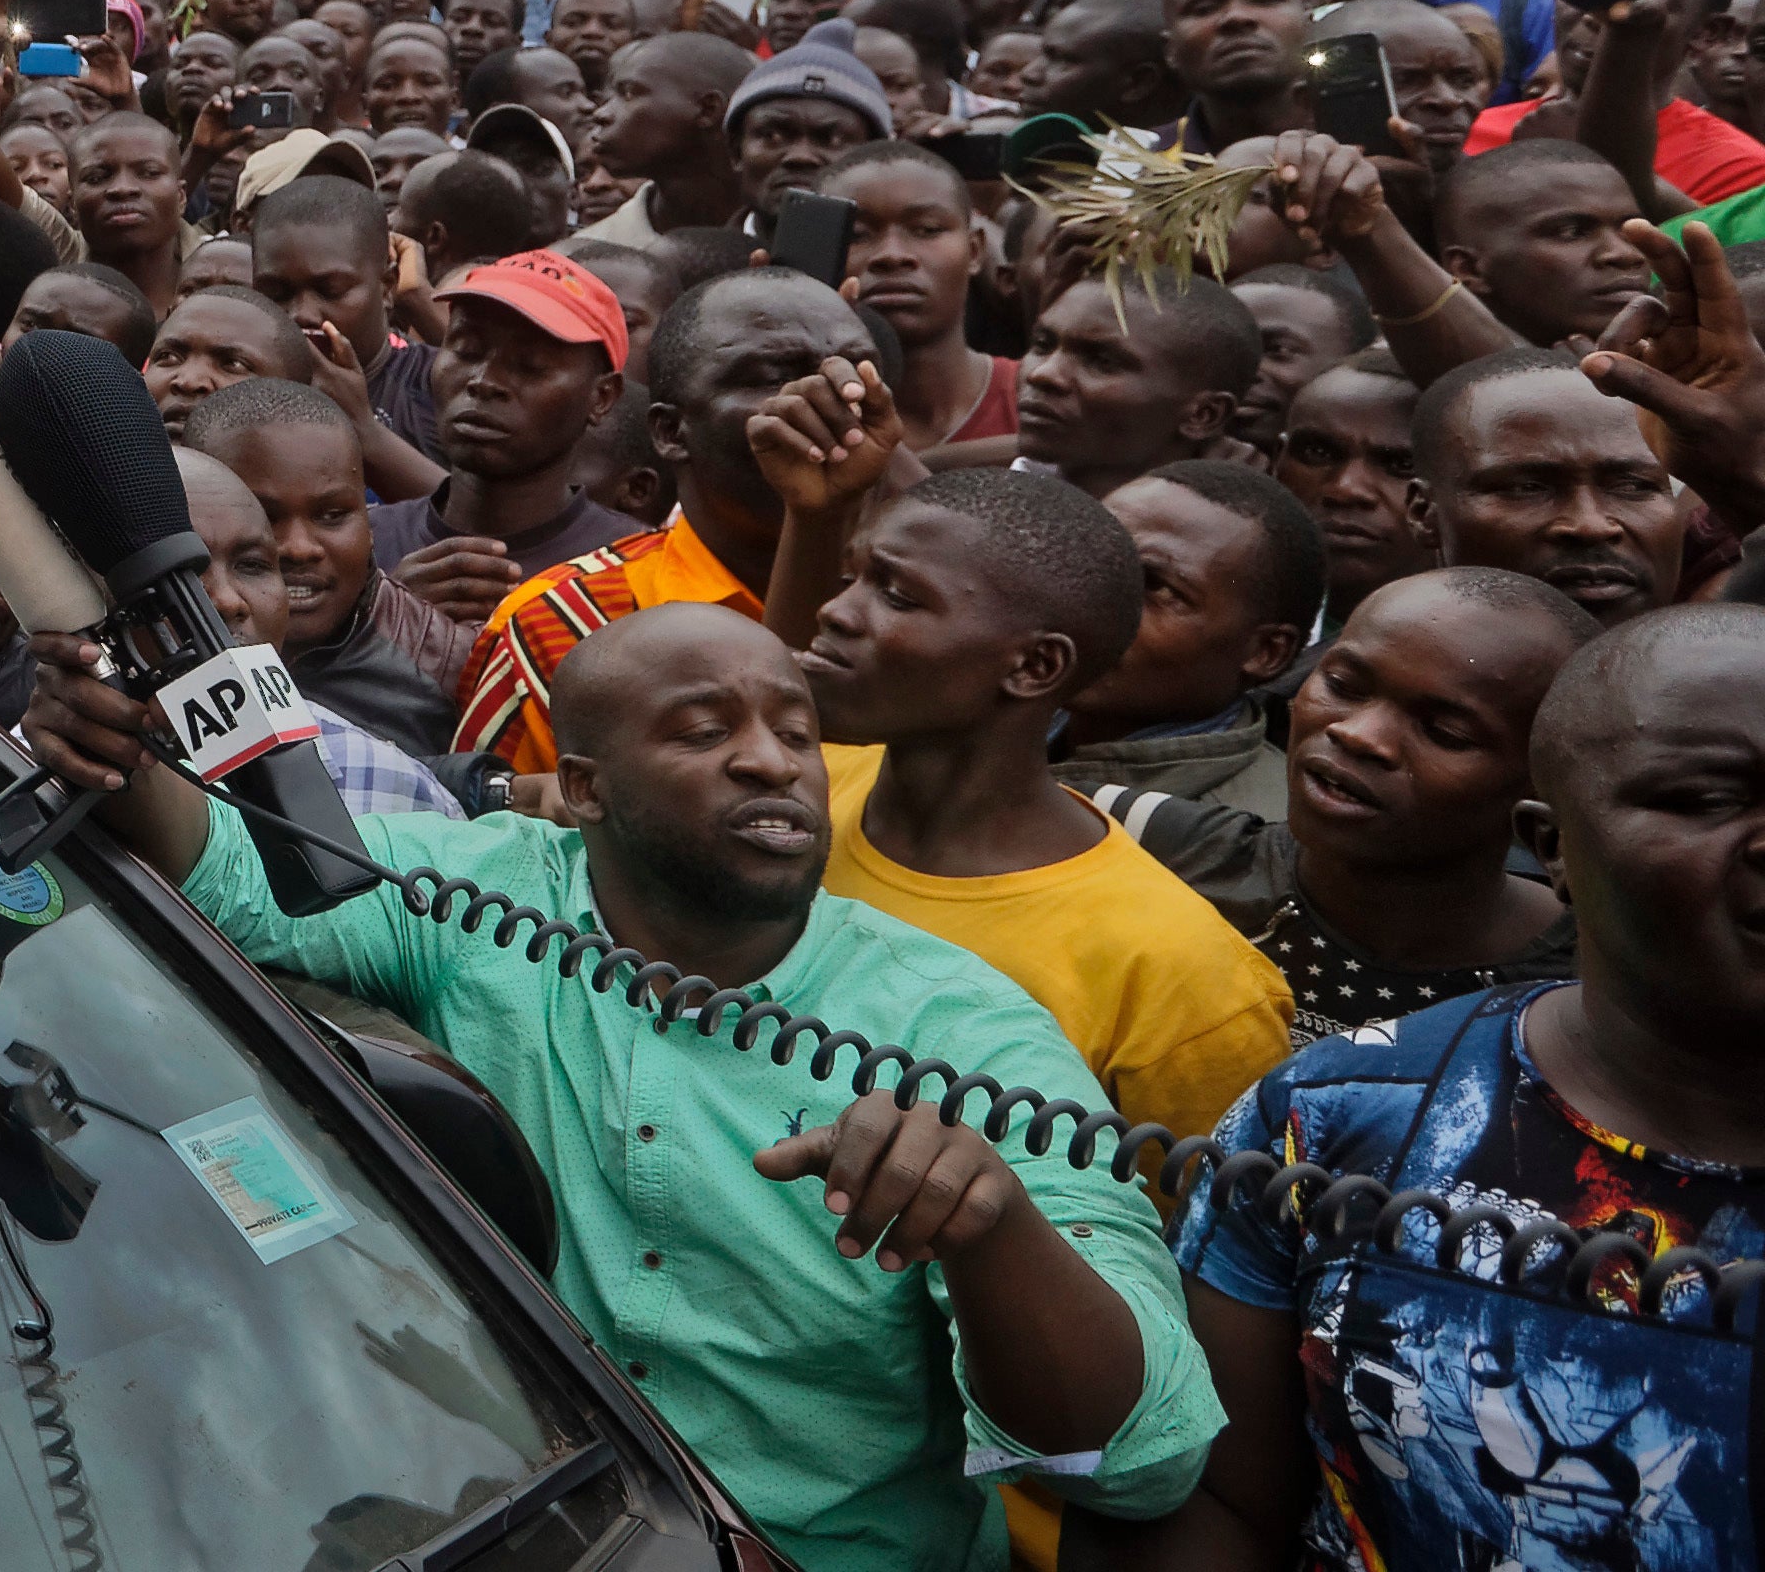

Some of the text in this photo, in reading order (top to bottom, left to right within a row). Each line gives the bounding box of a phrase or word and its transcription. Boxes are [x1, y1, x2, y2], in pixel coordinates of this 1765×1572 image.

[251, 665, 292, 713] AP
[182, 678, 246, 753] AP
[257, 1208, 292, 1229] PRIVATE
